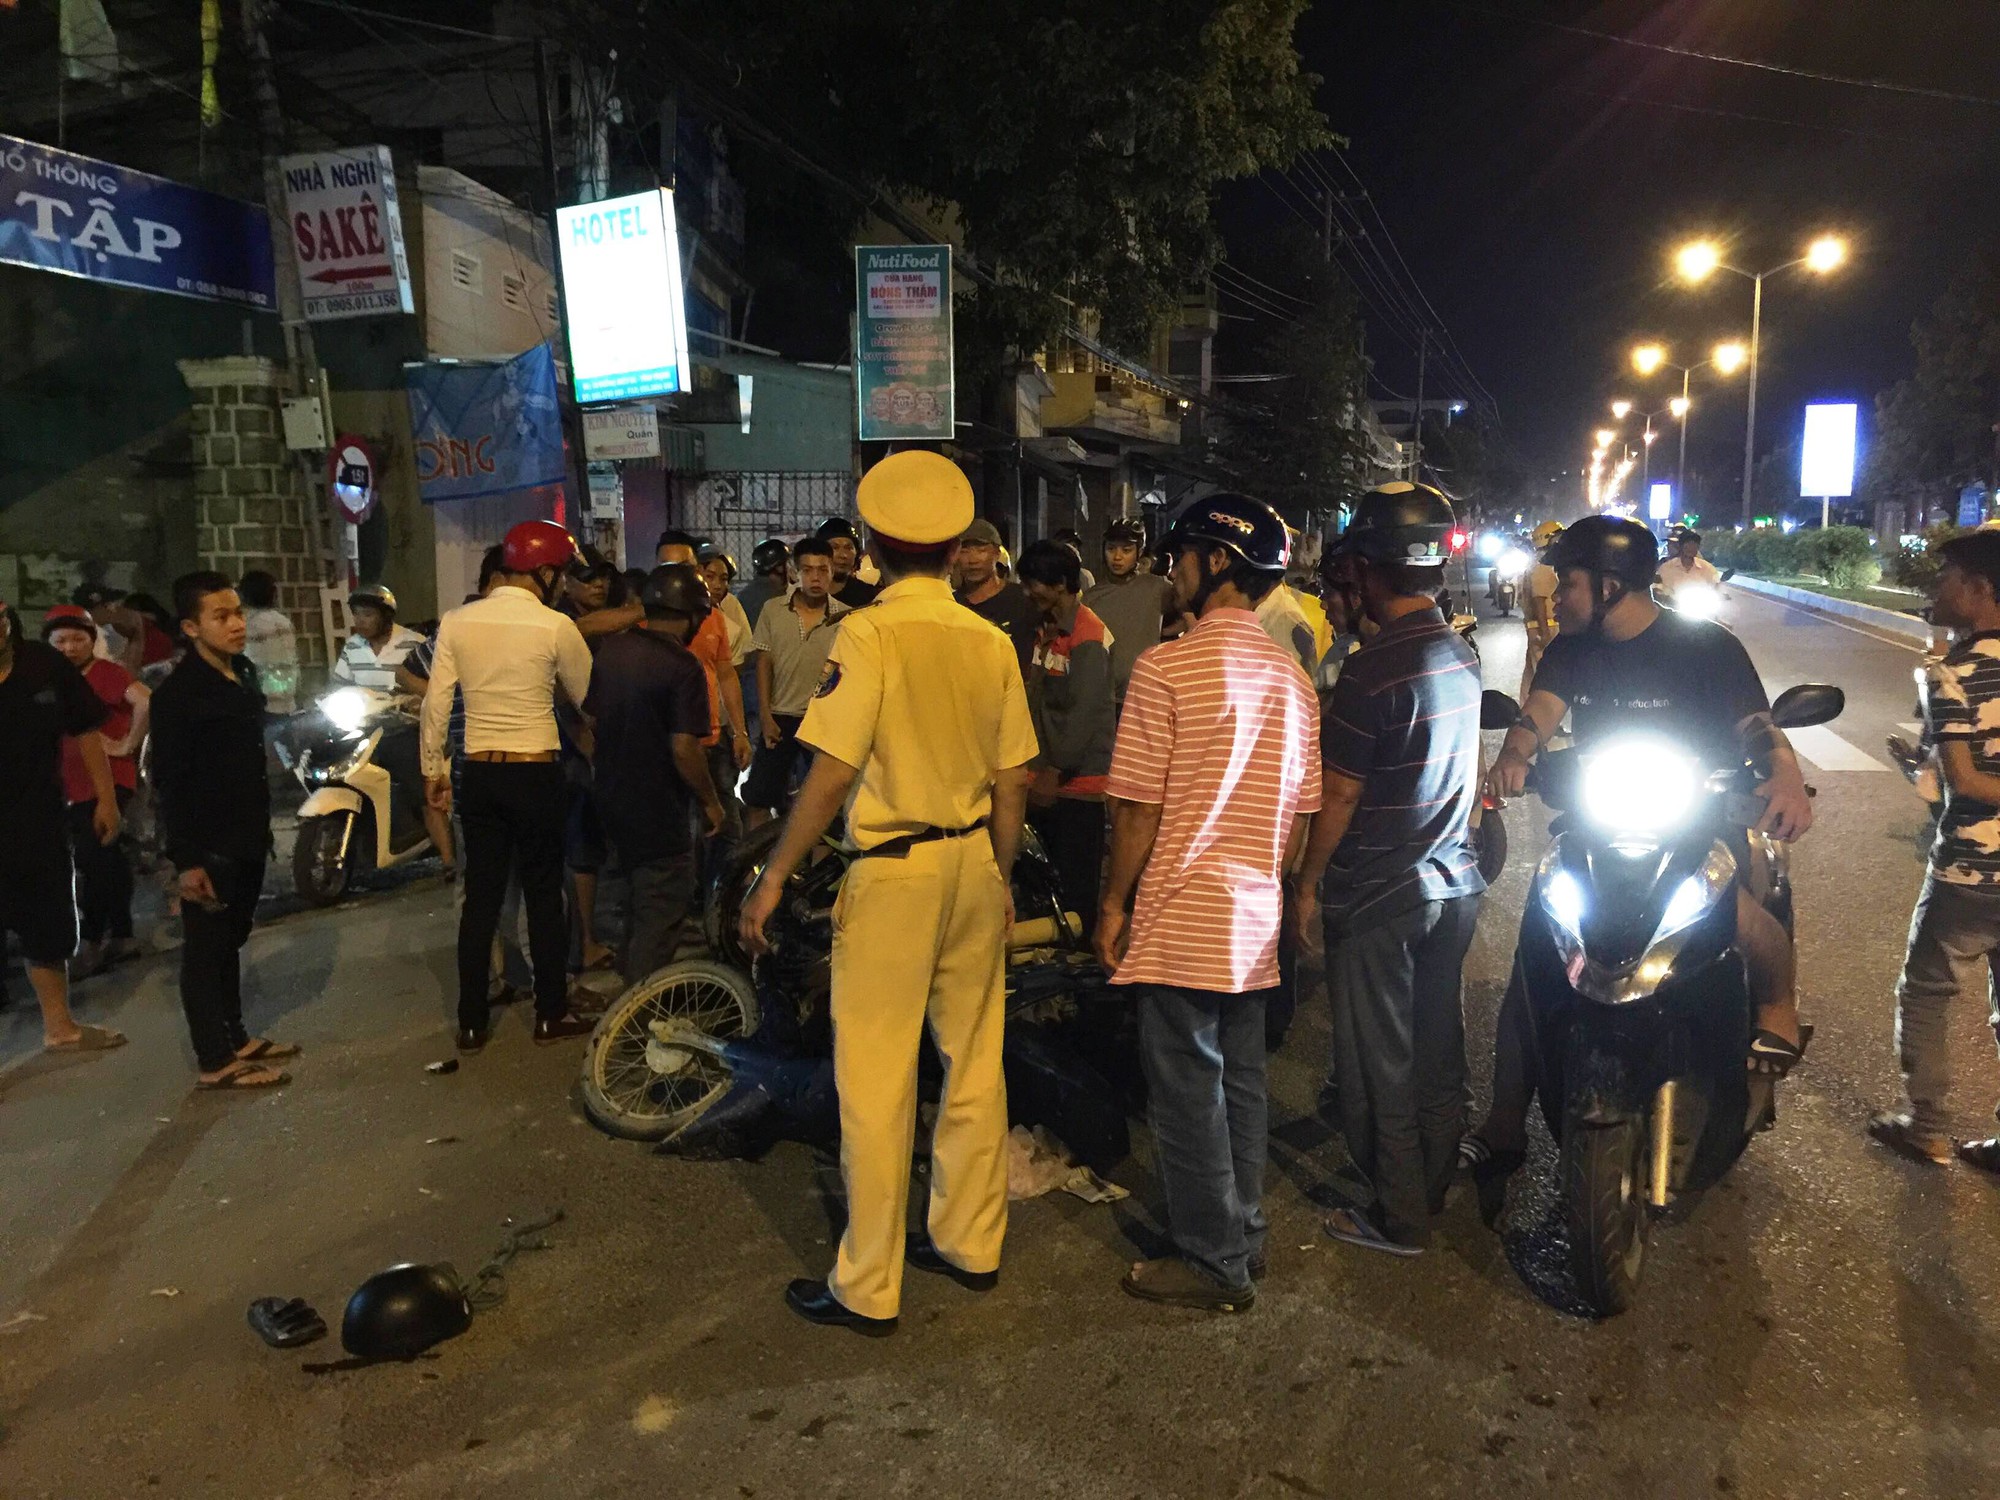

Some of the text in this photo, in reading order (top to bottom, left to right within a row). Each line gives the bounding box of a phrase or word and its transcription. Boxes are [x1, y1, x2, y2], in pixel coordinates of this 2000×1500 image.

[32, 157, 118, 195] THÔNG
[286, 150, 377, 193] NHÀ NGHỈ
[15, 190, 182, 264] TẬP
[294, 189, 386, 262] SAKÊ
[571, 205, 648, 247] HOTEL
[626, 429, 654, 440] Quán
